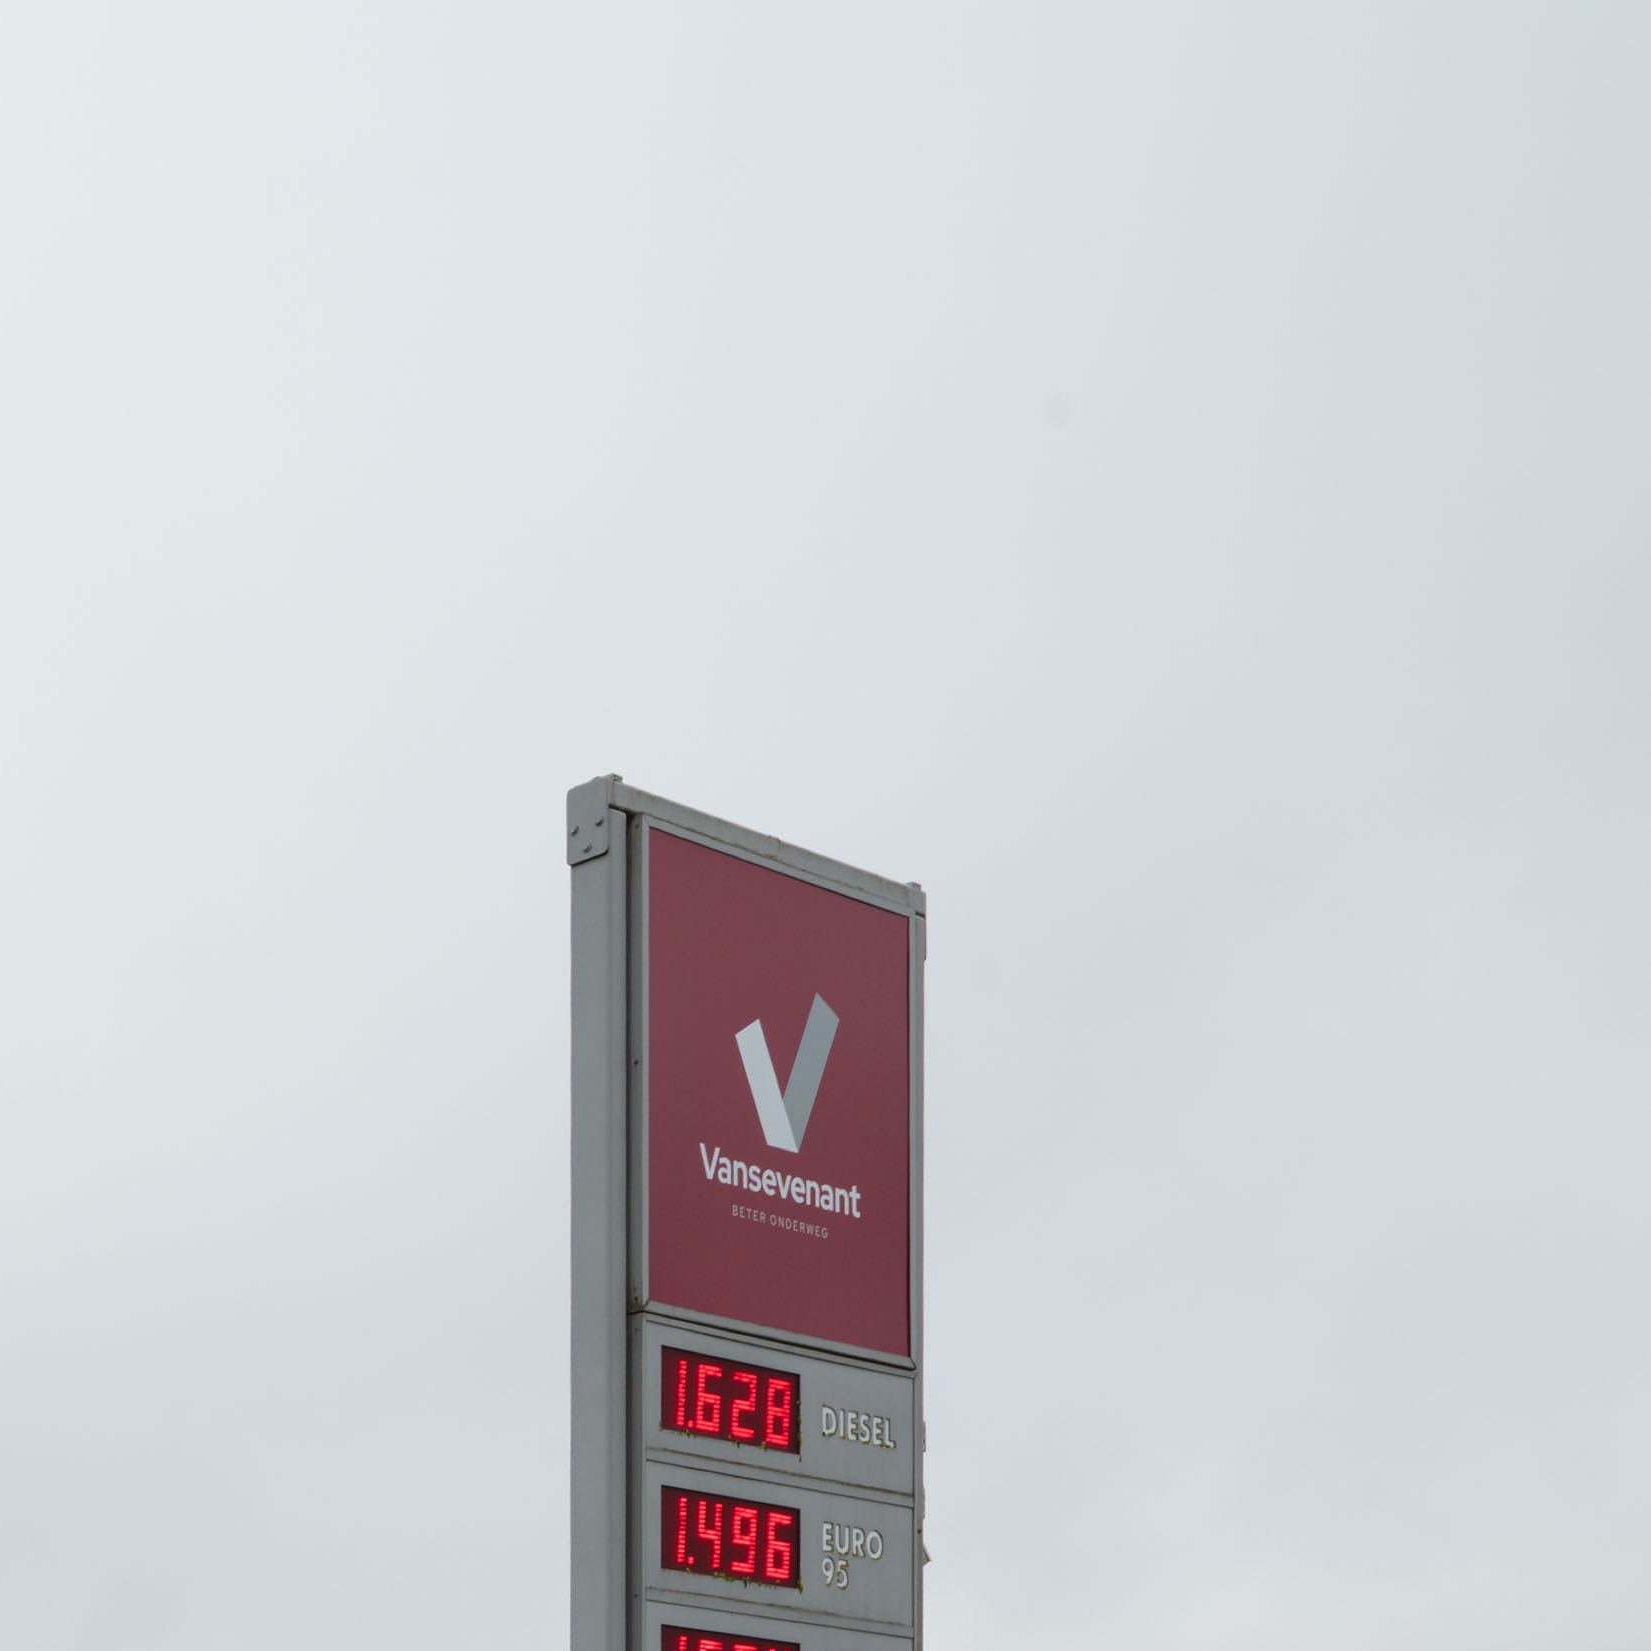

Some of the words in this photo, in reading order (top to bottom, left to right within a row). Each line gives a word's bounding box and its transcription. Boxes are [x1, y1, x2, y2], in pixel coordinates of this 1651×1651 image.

[699, 1142, 861, 1218] Vansevenant
[732, 1204, 766, 1224] BETER
[770, 1214, 829, 1239] ONDERWEG
[676, 1360, 792, 1446] 1.628
[822, 1405, 896, 1448] DIESEL
[676, 1497, 792, 1580] 1.496
[822, 1521, 884, 1560] EURO
[822, 1557, 849, 1590] 95
